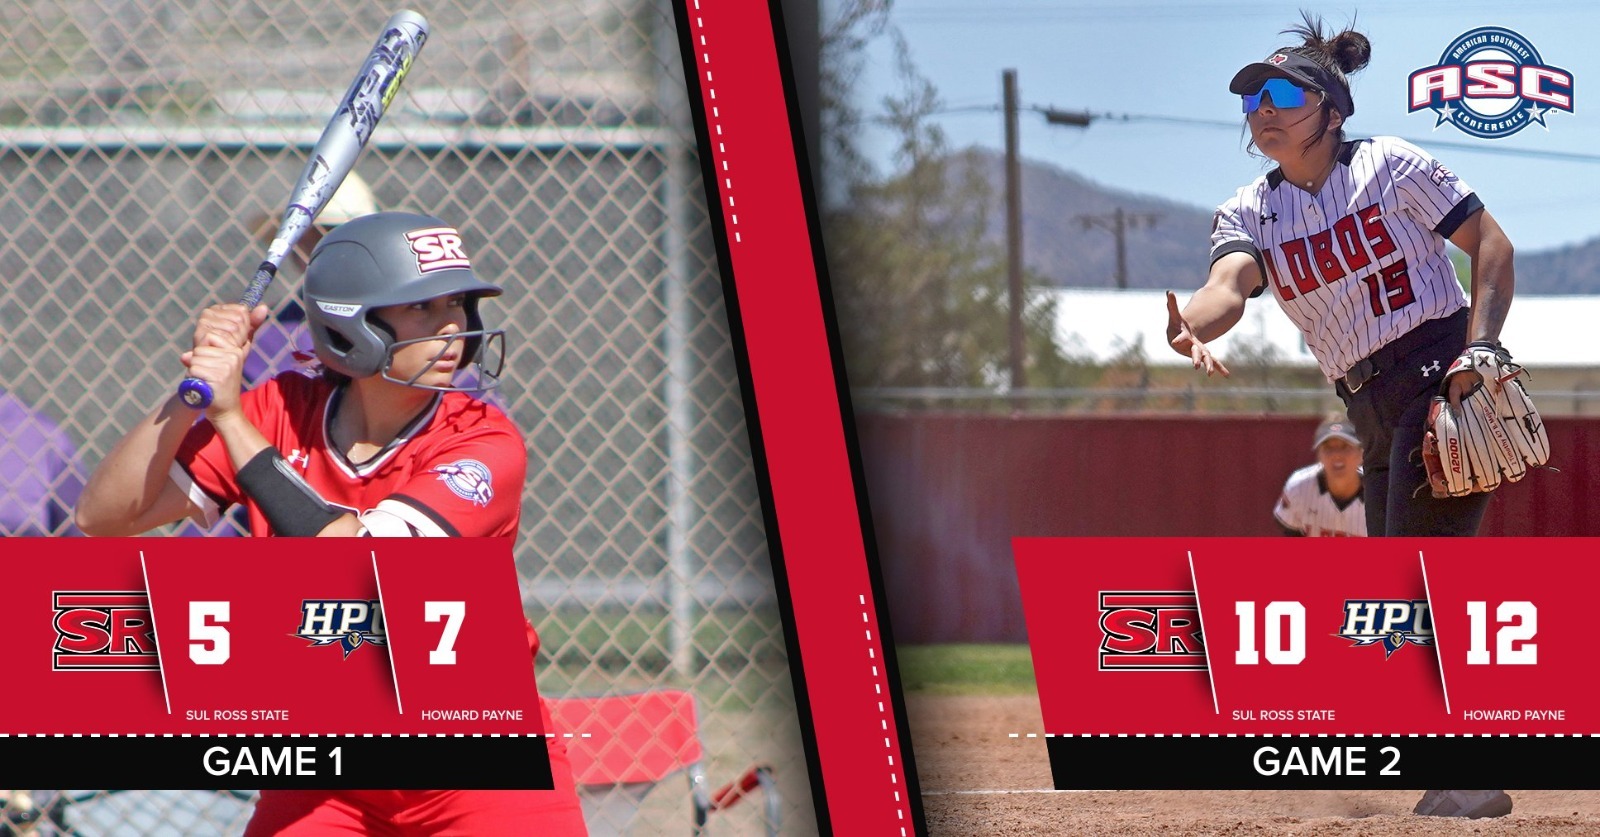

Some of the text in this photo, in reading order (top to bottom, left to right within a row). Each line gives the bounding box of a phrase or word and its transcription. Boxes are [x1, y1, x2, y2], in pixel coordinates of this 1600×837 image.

[409, 232, 470, 264] SR
[1263, 202, 1397, 301] LOBOS
[1362, 257, 1416, 318] 15
[323, 304, 355, 313] EASTON
[1449, 437, 1462, 474] A2000
